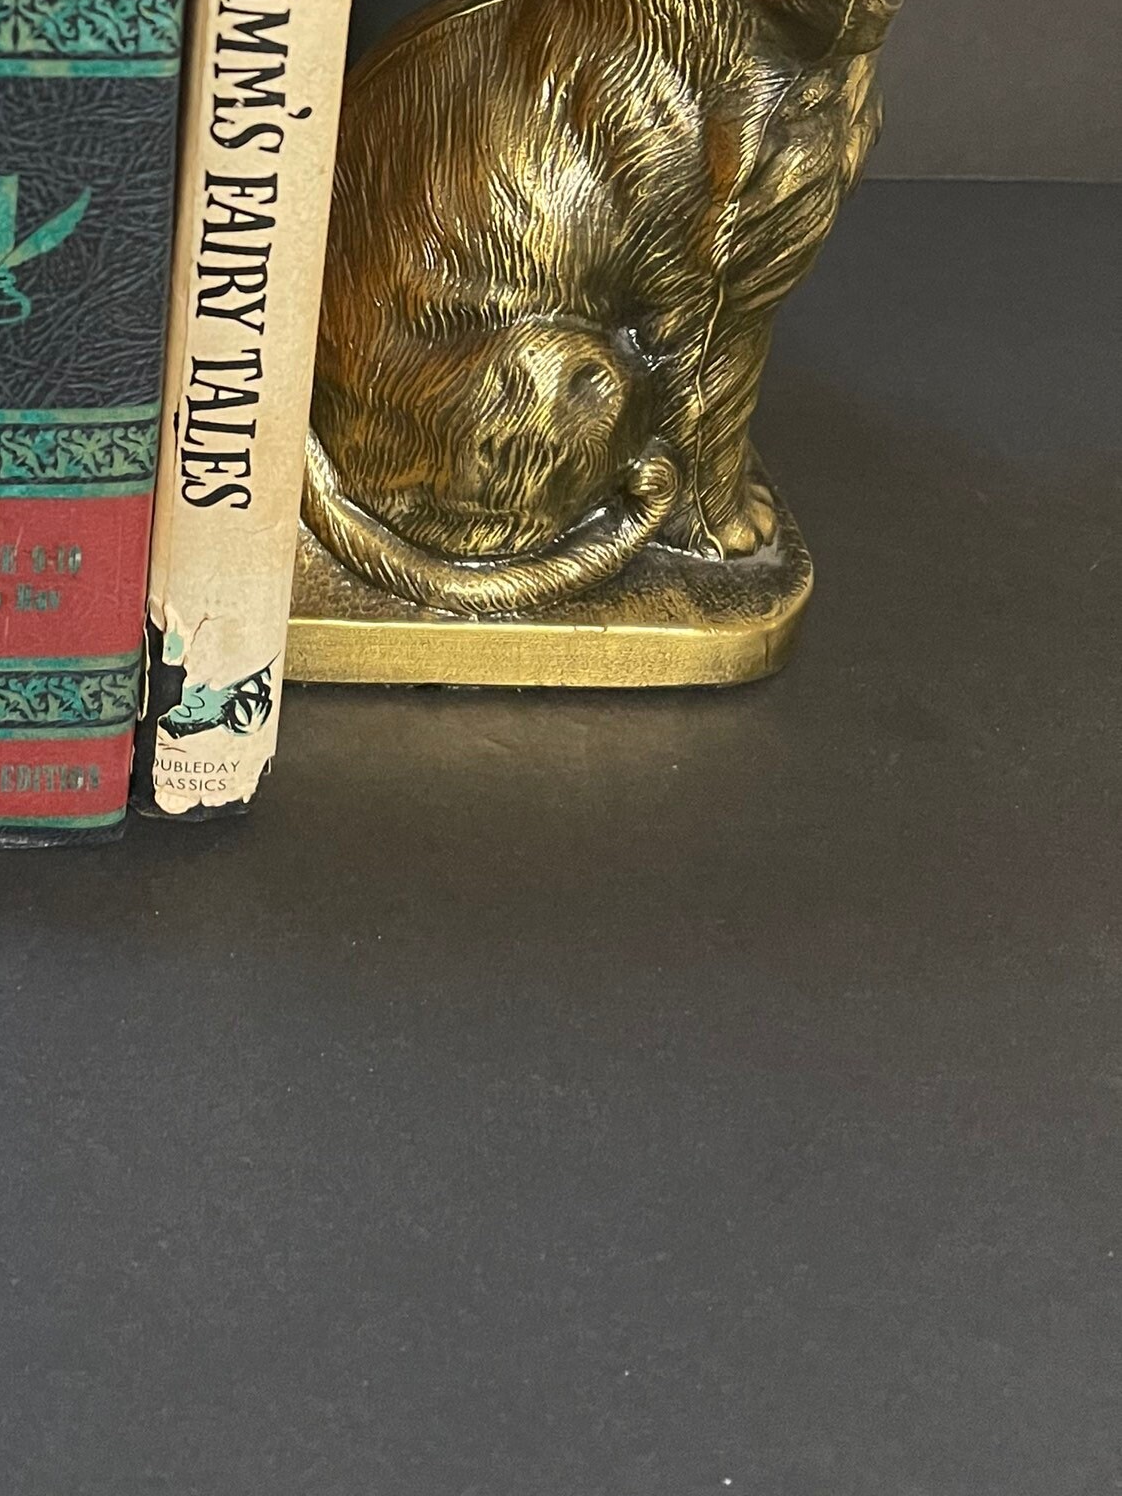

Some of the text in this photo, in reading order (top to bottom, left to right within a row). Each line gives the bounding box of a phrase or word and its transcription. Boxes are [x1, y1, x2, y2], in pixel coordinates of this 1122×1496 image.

[196, 168, 278, 336] FAIRY
[181, 348, 264, 510] TALES
[0, 762, 100, 793] EDITION
[154, 758, 241, 774] UBLEDAY
[154, 775, 227, 792] LASSICS
